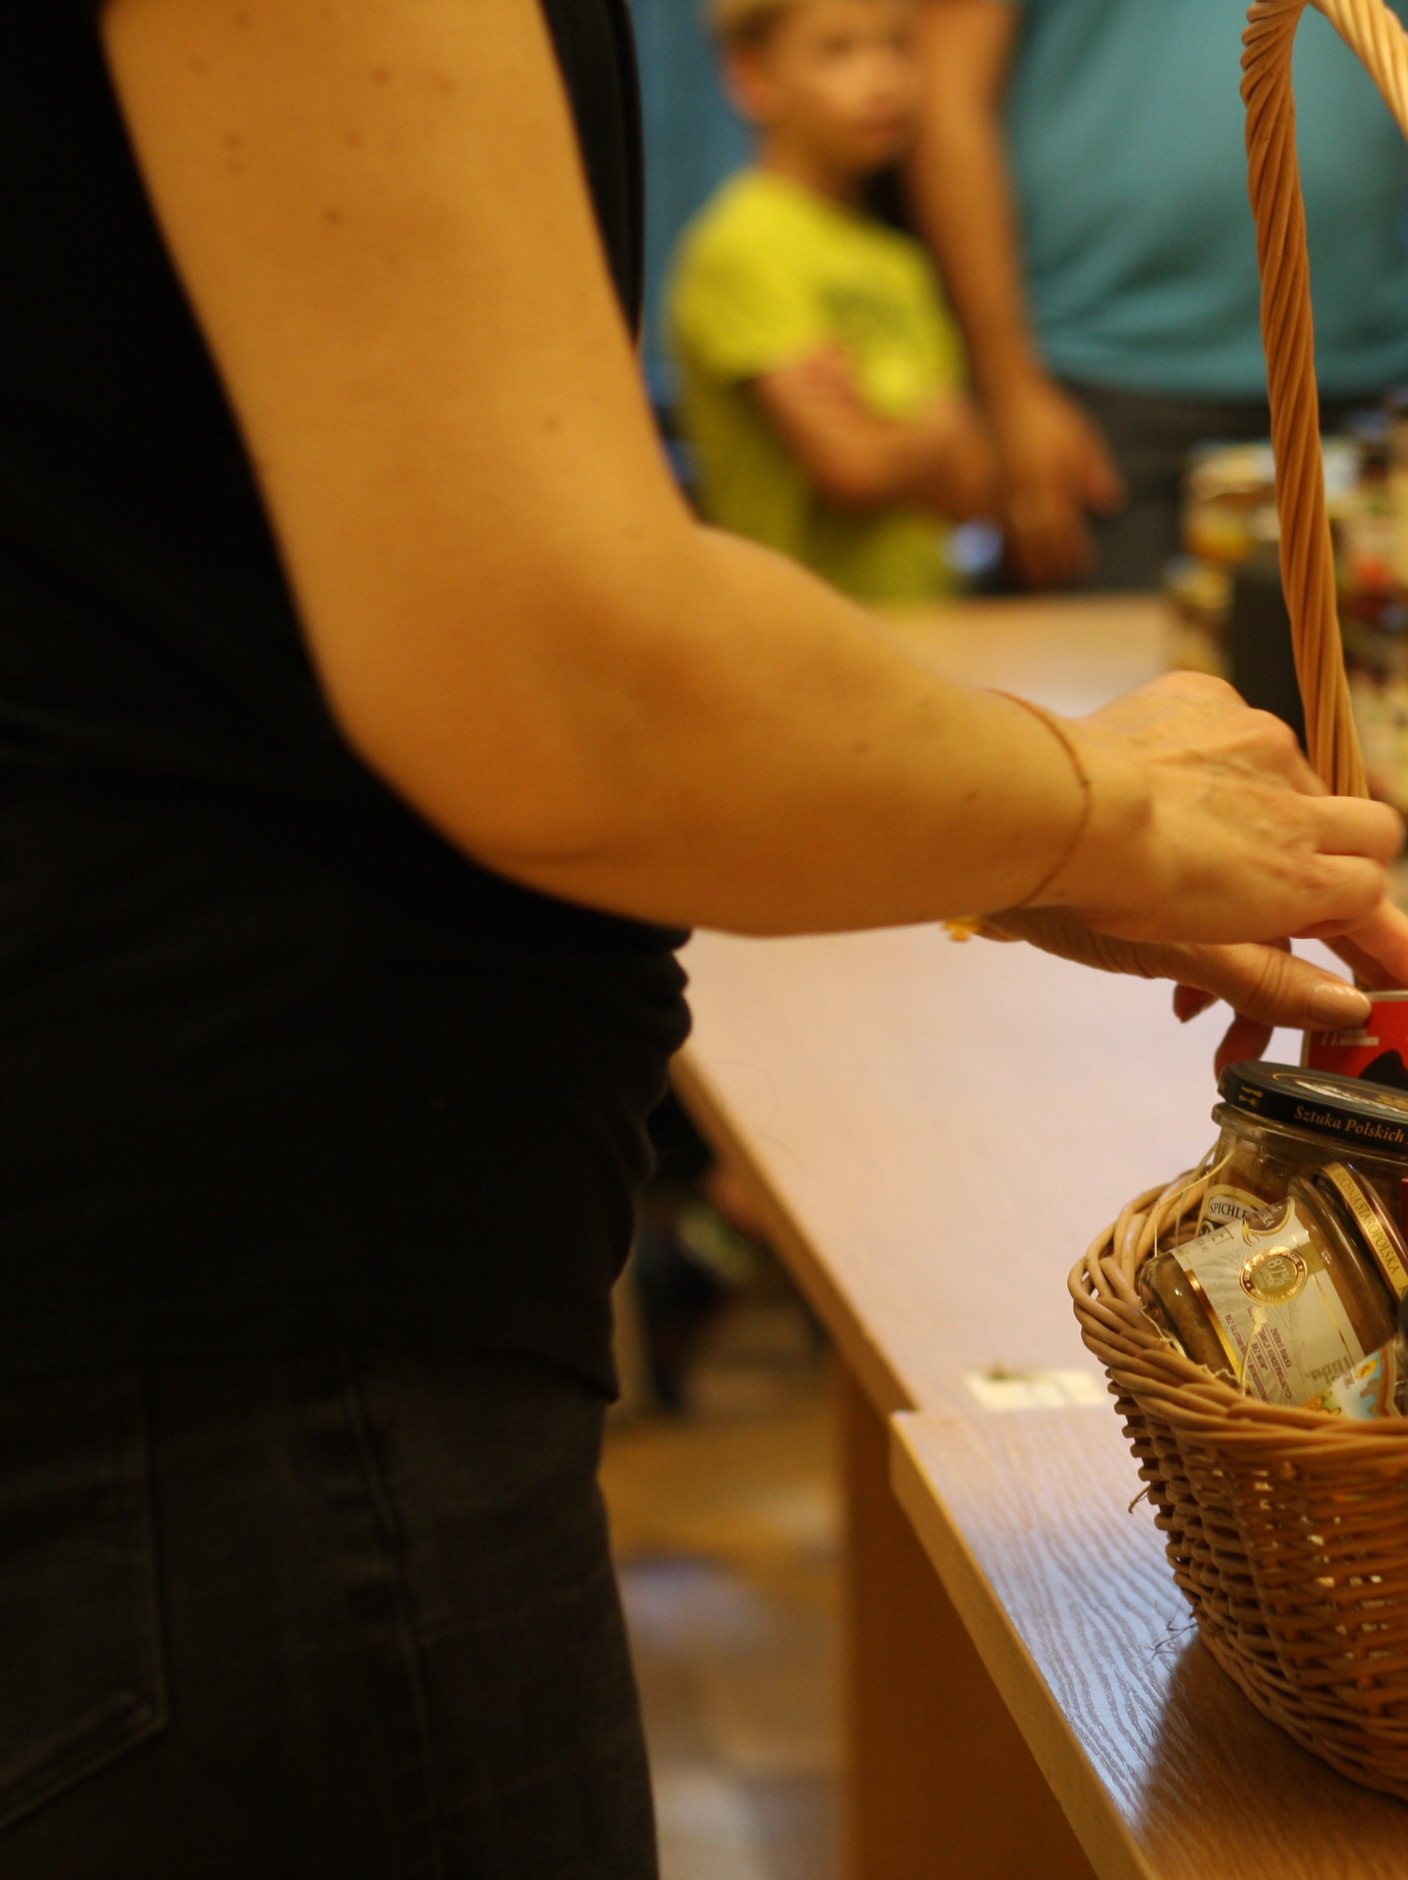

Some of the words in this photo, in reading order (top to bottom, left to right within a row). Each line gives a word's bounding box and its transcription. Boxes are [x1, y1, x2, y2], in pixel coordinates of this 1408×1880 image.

[1294, 1105, 1342, 1131] Sztuka
[1344, 1118, 1405, 1143] Polskich
[1356, 1203, 1399, 1276] STAROPOLSKA
[1267, 1257, 1293, 1288] 87%
